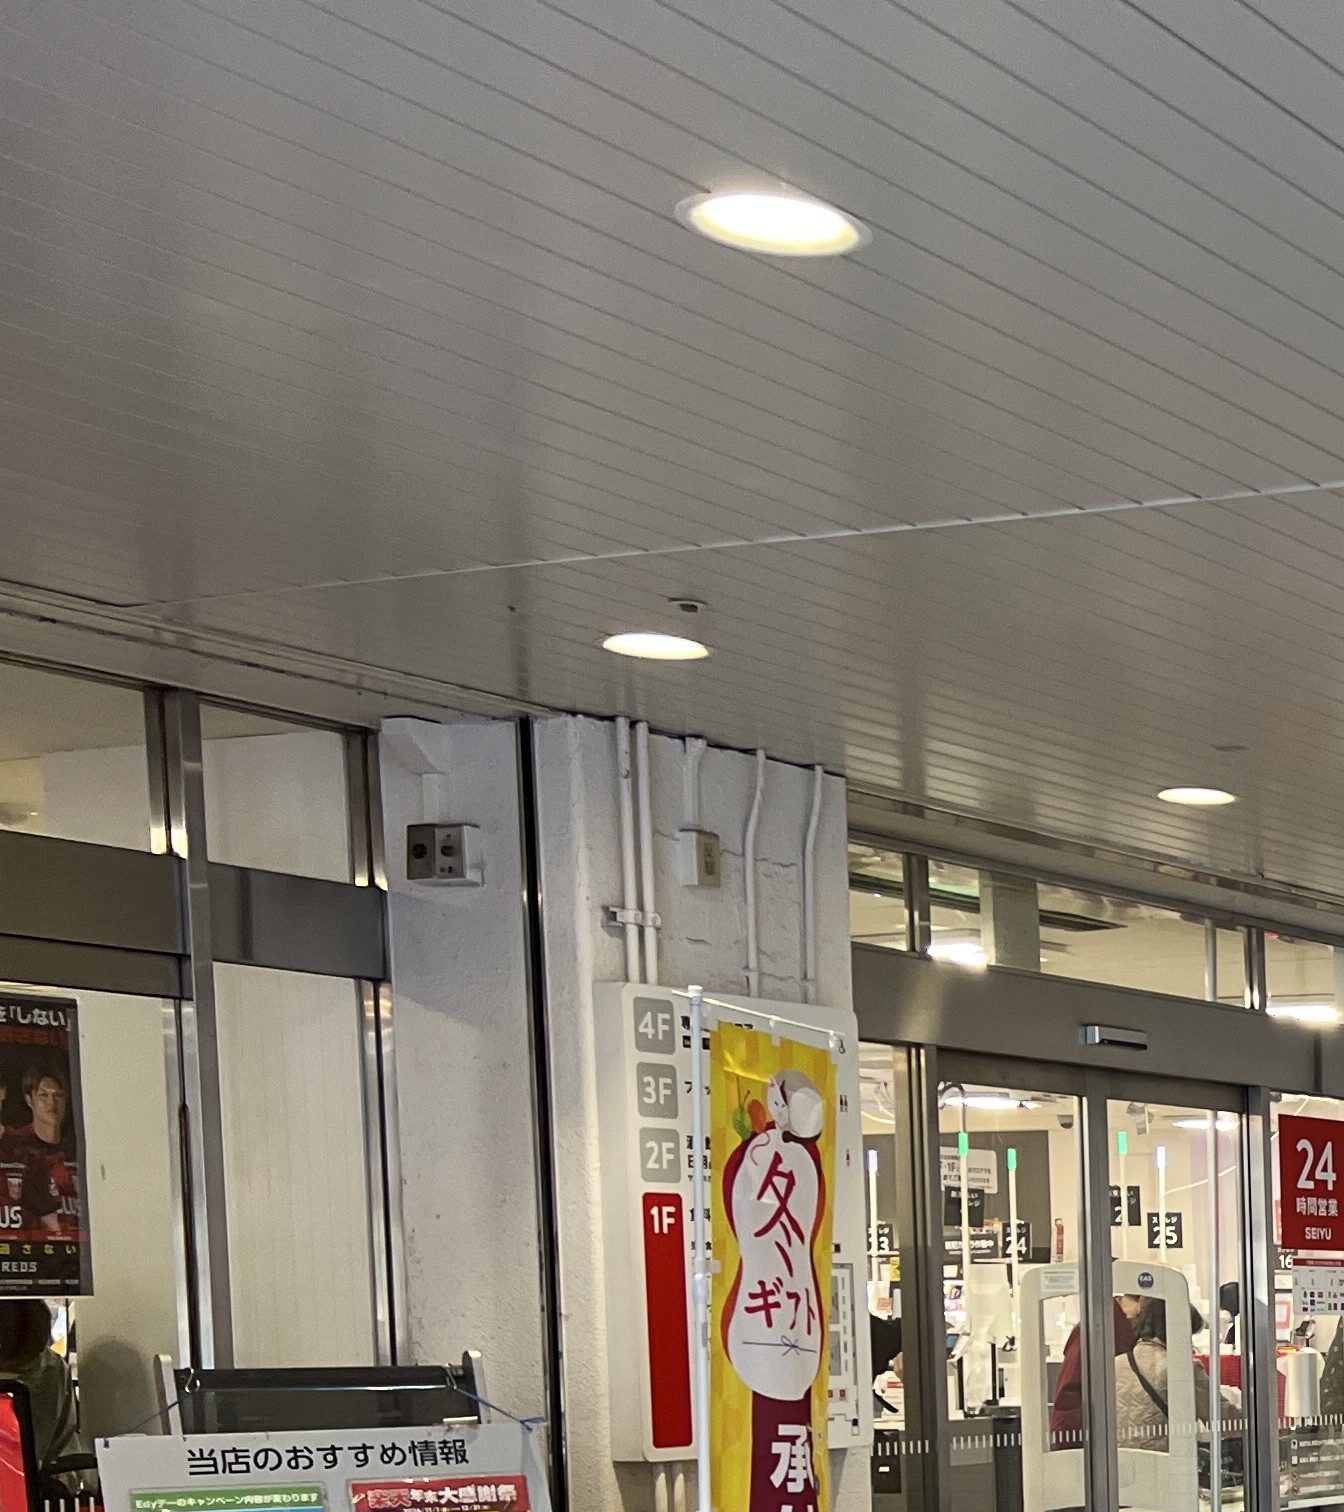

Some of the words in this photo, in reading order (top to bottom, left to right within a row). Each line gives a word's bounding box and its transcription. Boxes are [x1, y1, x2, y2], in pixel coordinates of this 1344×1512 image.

[638, 1012, 671, 1040] 4F
[642, 1075, 673, 1106] 3F
[645, 1140, 676, 1171] 2F
[1296, 1138, 1337, 1191] 24
[650, 1206, 676, 1235] 1F
[1296, 1196, 1338, 1217] 時間営業
[1005, 1236, 1027, 1255] 24
[1152, 1225, 1178, 1245] 25
[1304, 1227, 1332, 1240] SEIYU
[1, 1261, 38, 1273] REDS
[186, 1438, 470, 1477] 当店のおすすめ情報
